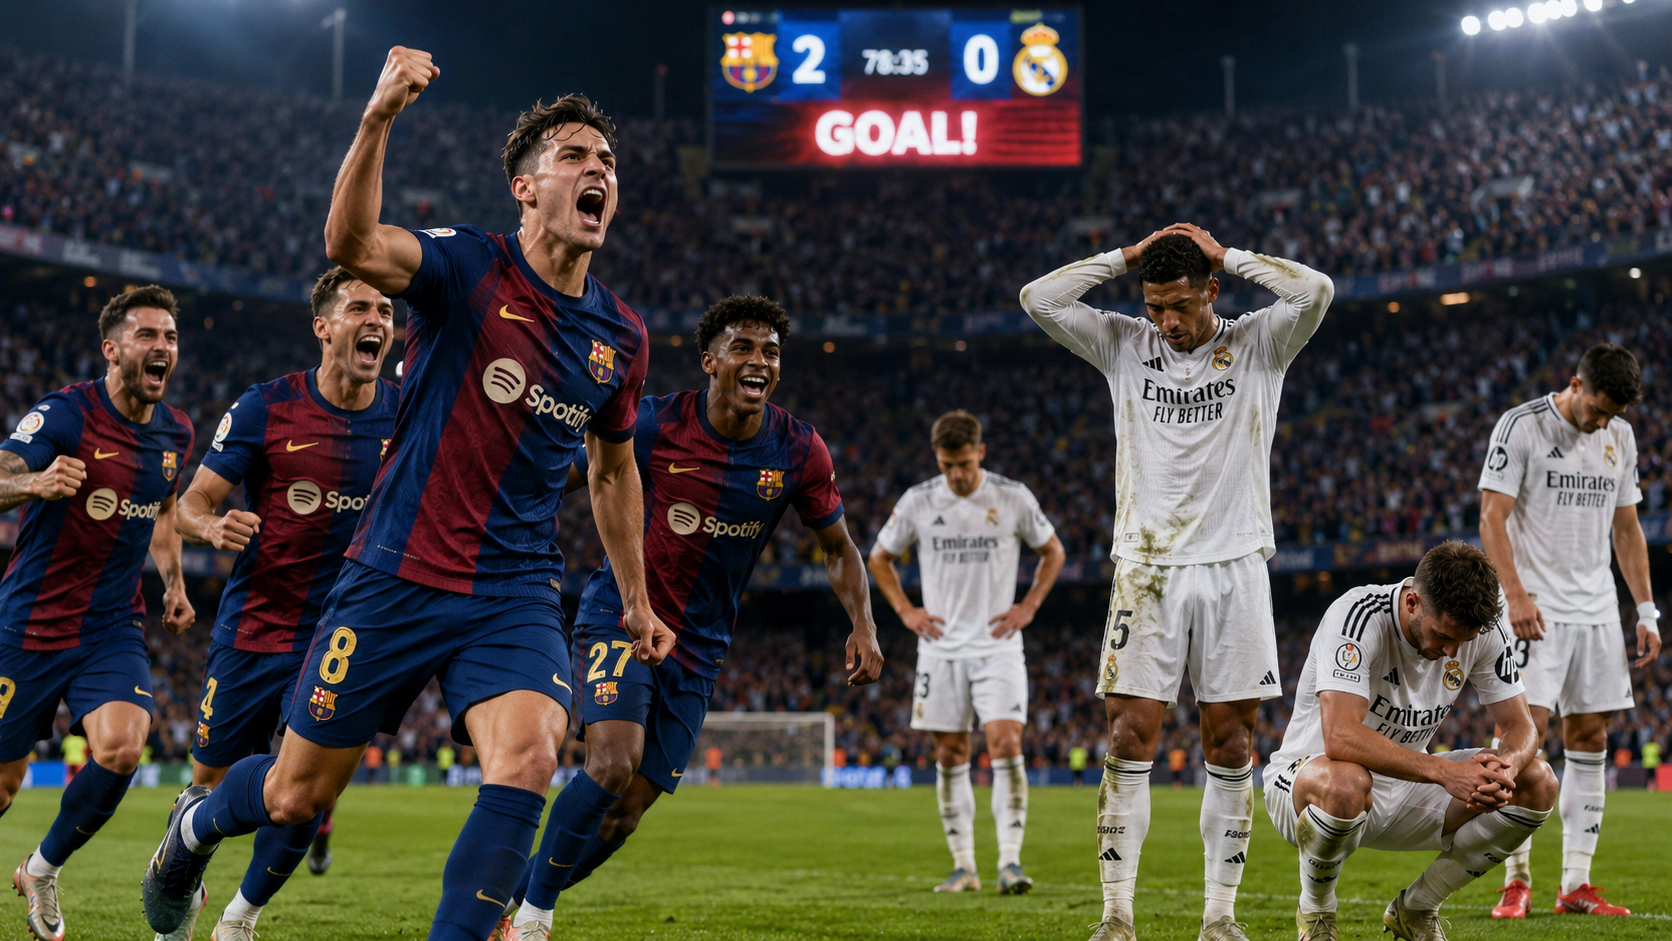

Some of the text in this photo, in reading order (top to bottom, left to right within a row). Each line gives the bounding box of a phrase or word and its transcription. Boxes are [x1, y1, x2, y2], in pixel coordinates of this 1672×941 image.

[792, 34, 826, 84] 2
[963, 34, 999, 84] 0
[814, 110, 978, 156] GOAL!
[525, 384, 592, 433] Spotify
[1142, 378, 1236, 405] Emirates
[1153, 402, 1223, 424] FLY BETTER
[1546, 470, 1615, 491] Emirates
[324, 490, 370, 513] Spo
[1557, 491, 1607, 507] FLY BETTER
[702, 516, 764, 539] Spotify
[932, 533, 999, 551] Emirates
[1110, 610, 1133, 650] 5
[319, 626, 357, 684] 8
[587, 640, 633, 683] 27
[200, 677, 218, 720] 4
[1369, 694, 1455, 727] Emirate
